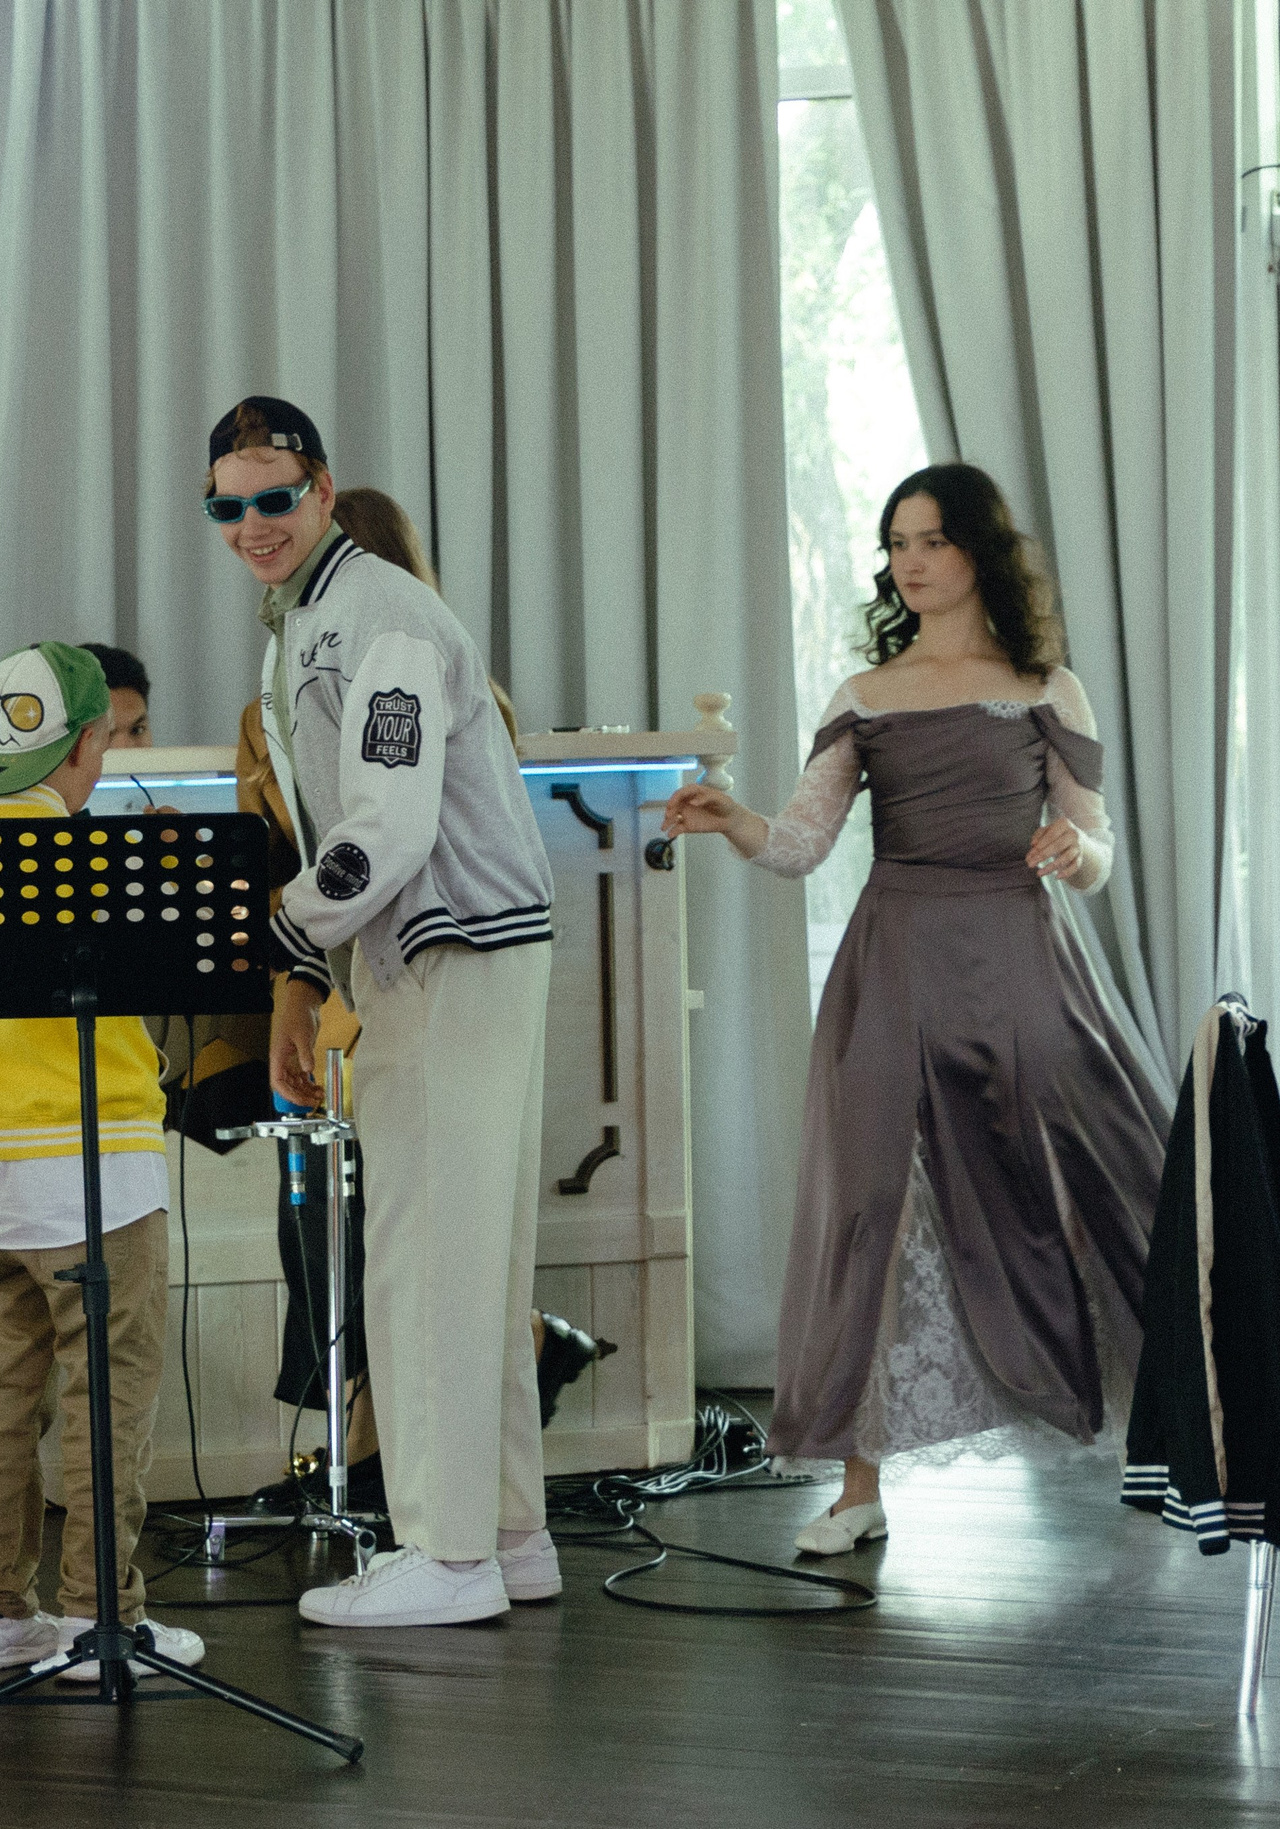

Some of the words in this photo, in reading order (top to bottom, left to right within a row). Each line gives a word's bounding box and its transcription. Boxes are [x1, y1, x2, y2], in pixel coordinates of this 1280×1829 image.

[378, 699, 413, 711] TRUST
[377, 715, 413, 742] YOUR
[376, 745, 408, 757] FEELS
